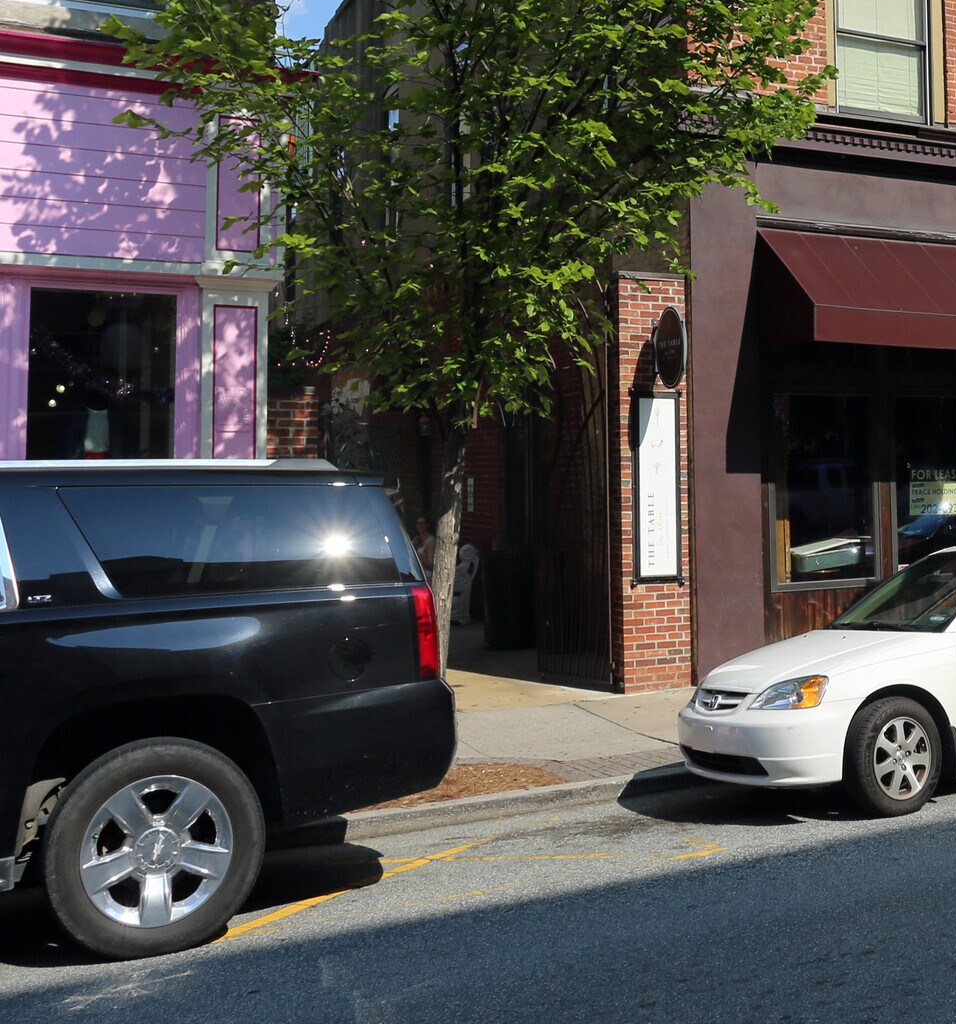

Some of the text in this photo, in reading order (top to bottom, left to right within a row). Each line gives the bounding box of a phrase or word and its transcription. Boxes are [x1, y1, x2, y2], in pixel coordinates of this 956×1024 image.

[658, 337, 681, 349] THE TABLE
[911, 469, 932, 480] FOR
[911, 488, 932, 496] TRACE
[647, 491, 655, 537] TABLE
